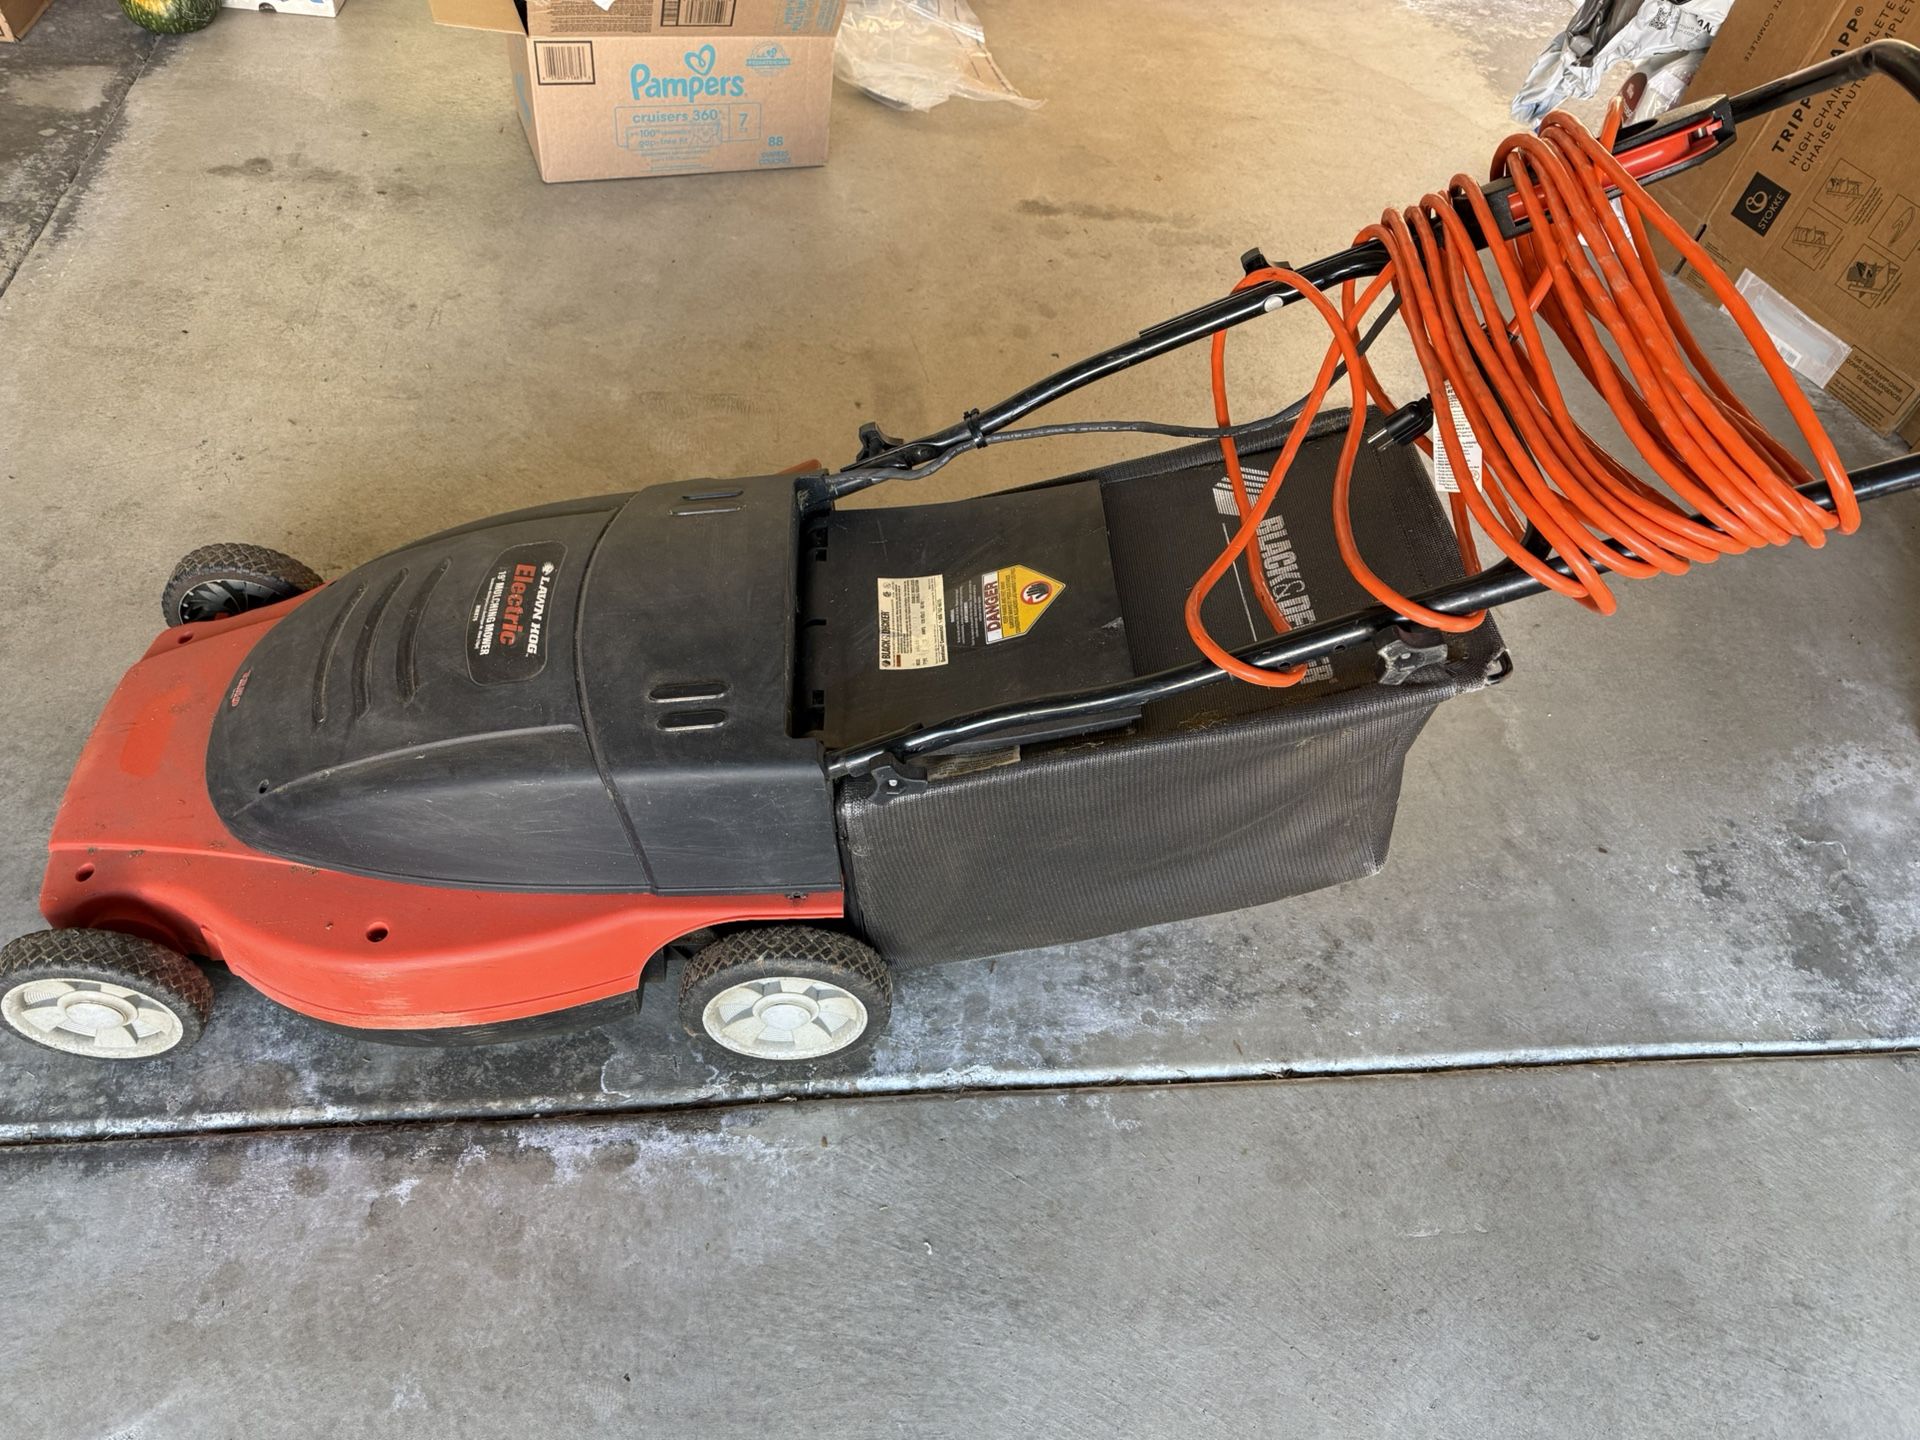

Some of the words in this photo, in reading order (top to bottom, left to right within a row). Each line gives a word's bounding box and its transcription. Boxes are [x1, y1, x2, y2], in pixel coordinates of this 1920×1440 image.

[630, 63, 745, 103] Pampers
[1788, 131, 1815, 166] HIGH
[1813, 86, 1845, 128] CHAIR
[1863, 0, 1896, 44] PLETE
[632, 111, 689, 123] cruisers
[739, 112, 748, 127] 7
[1771, 97, 1813, 153] TRIPP
[1801, 122, 1837, 172] CHAISE
[1834, 78, 1867, 120] HAUT
[767, 136, 784, 147] 88
[1758, 191, 1785, 230] STOKKE
[486, 581, 505, 624] MULCHING
[499, 563, 537, 646] Electric
[532, 575, 551, 621] LAWN
[984, 580, 1002, 632] DANGER
[479, 623, 495, 656] MOWER
[527, 621, 541, 655] HOG
